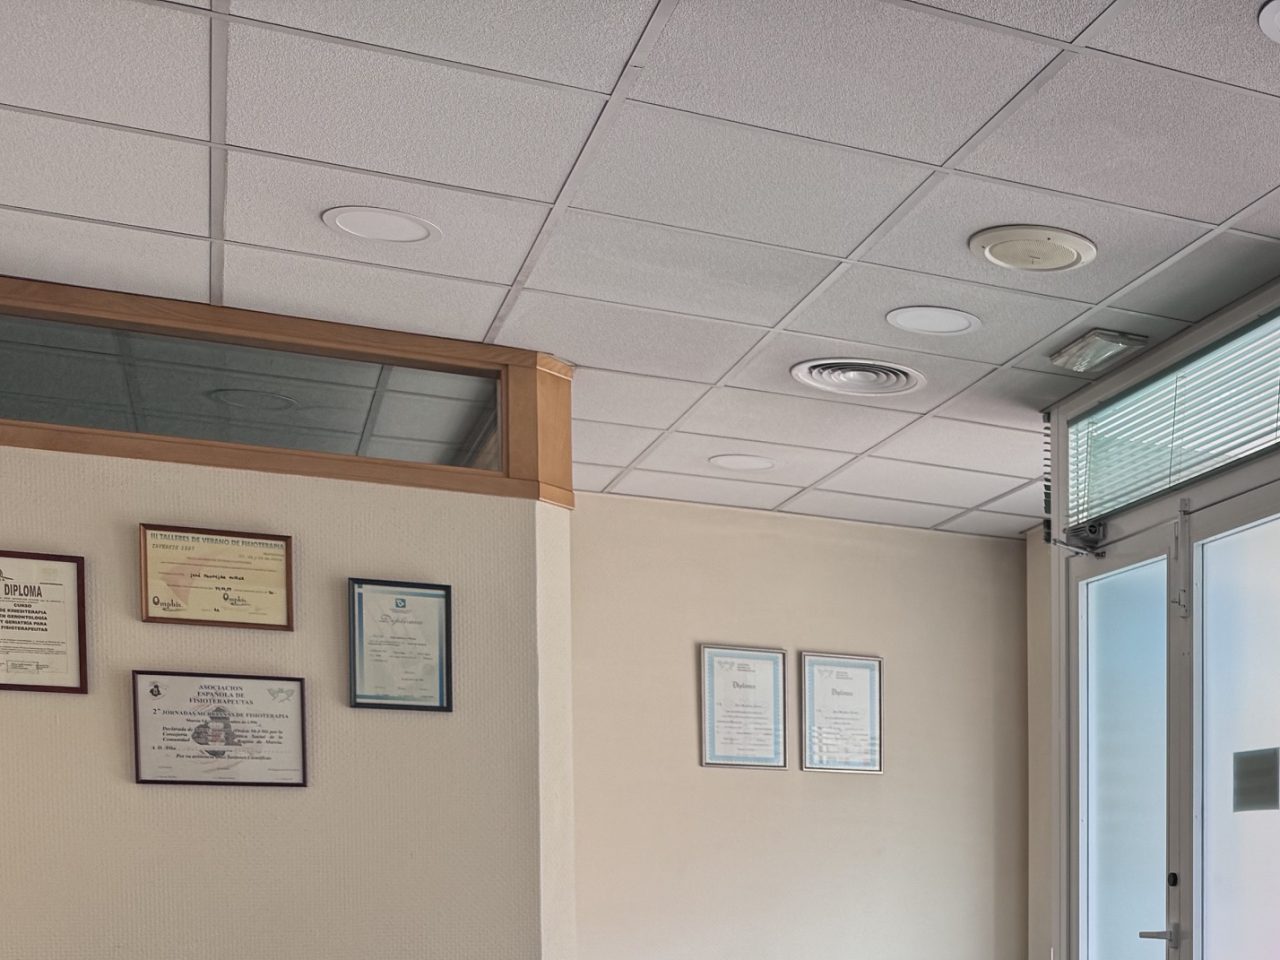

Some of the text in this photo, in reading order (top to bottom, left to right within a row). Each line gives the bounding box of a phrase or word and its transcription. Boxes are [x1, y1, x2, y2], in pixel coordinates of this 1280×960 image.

[191, 535, 200, 543] DE
[231, 538, 240, 546] DE
[4, 583, 42, 598] DIPLOMA
